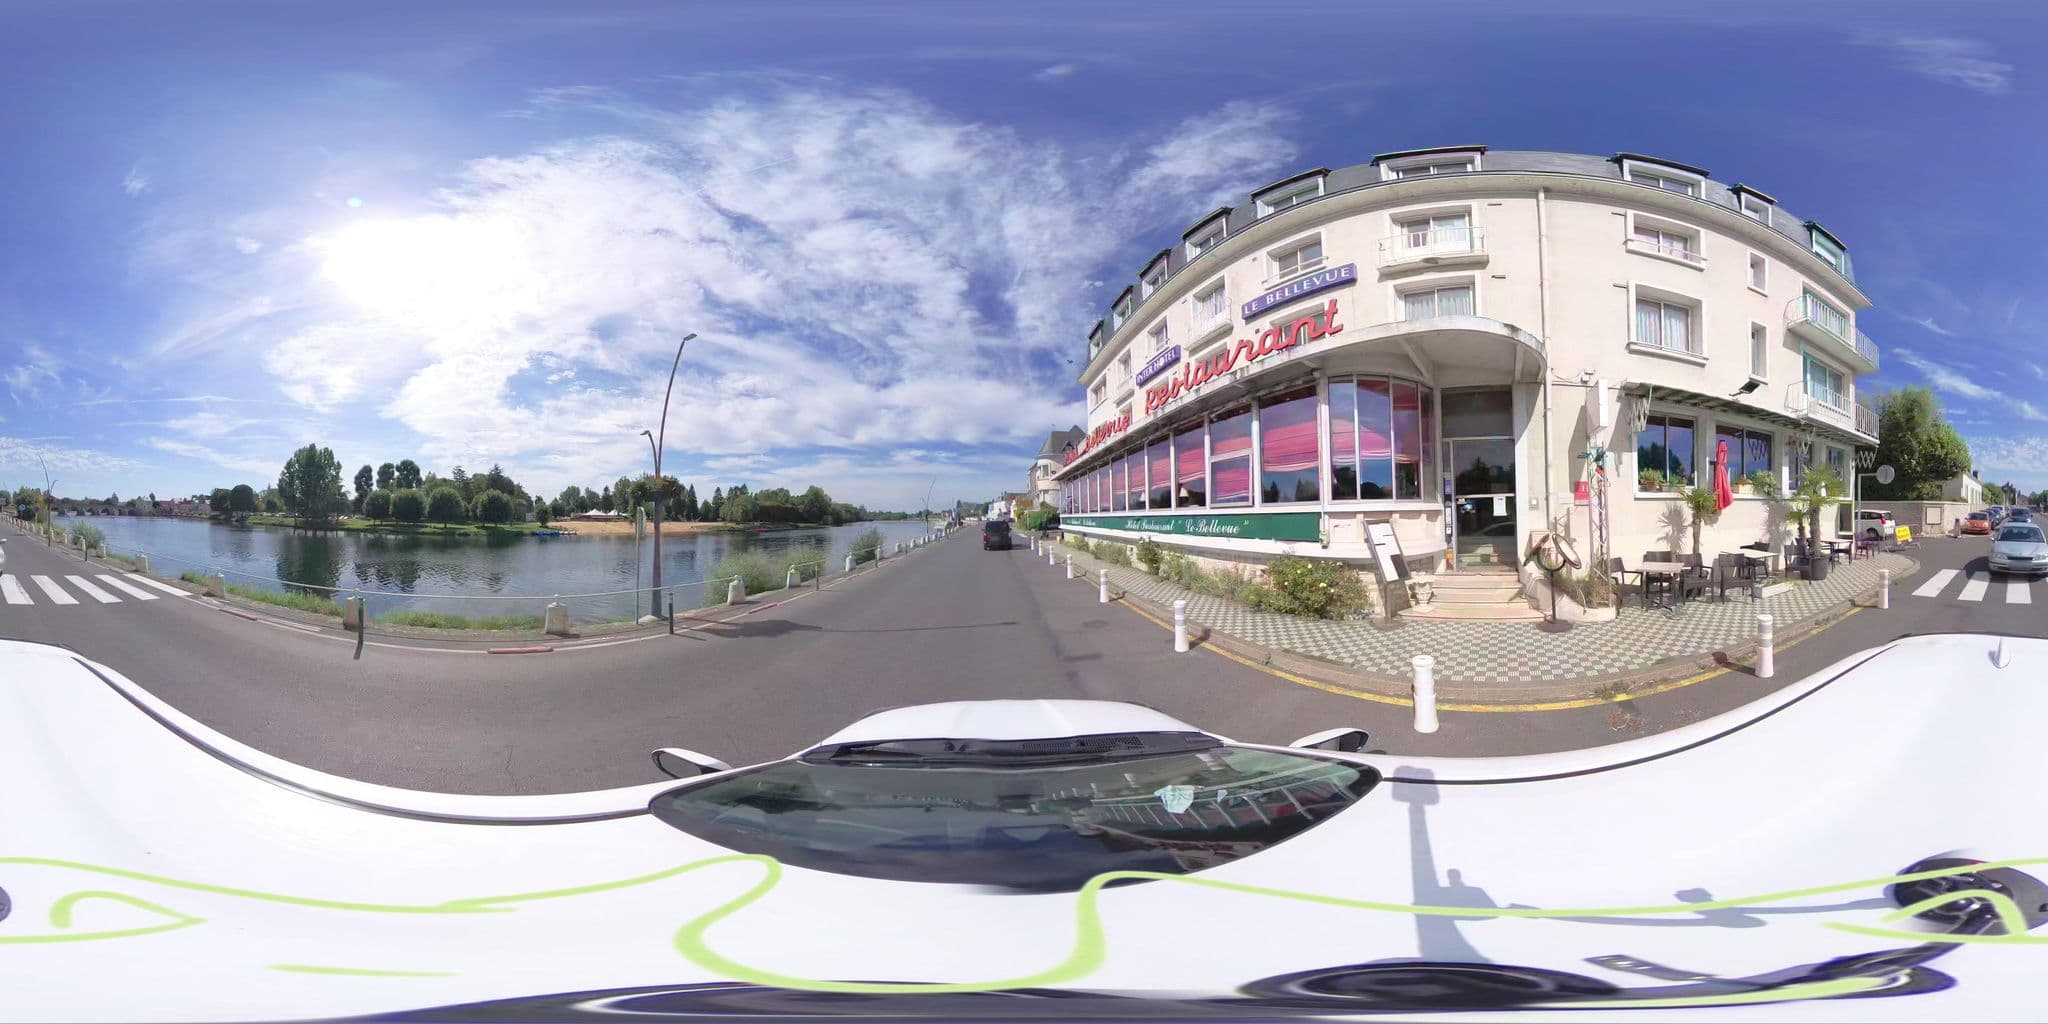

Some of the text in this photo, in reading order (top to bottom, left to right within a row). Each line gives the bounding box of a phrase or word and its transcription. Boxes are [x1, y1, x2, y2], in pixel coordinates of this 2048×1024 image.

[1244, 267, 1350, 314] LE BELLEVUE
[1144, 298, 1344, 415] Restaurant
[1185, 519, 1195, 532] Le
[1195, 519, 1240, 534] Bellevue
